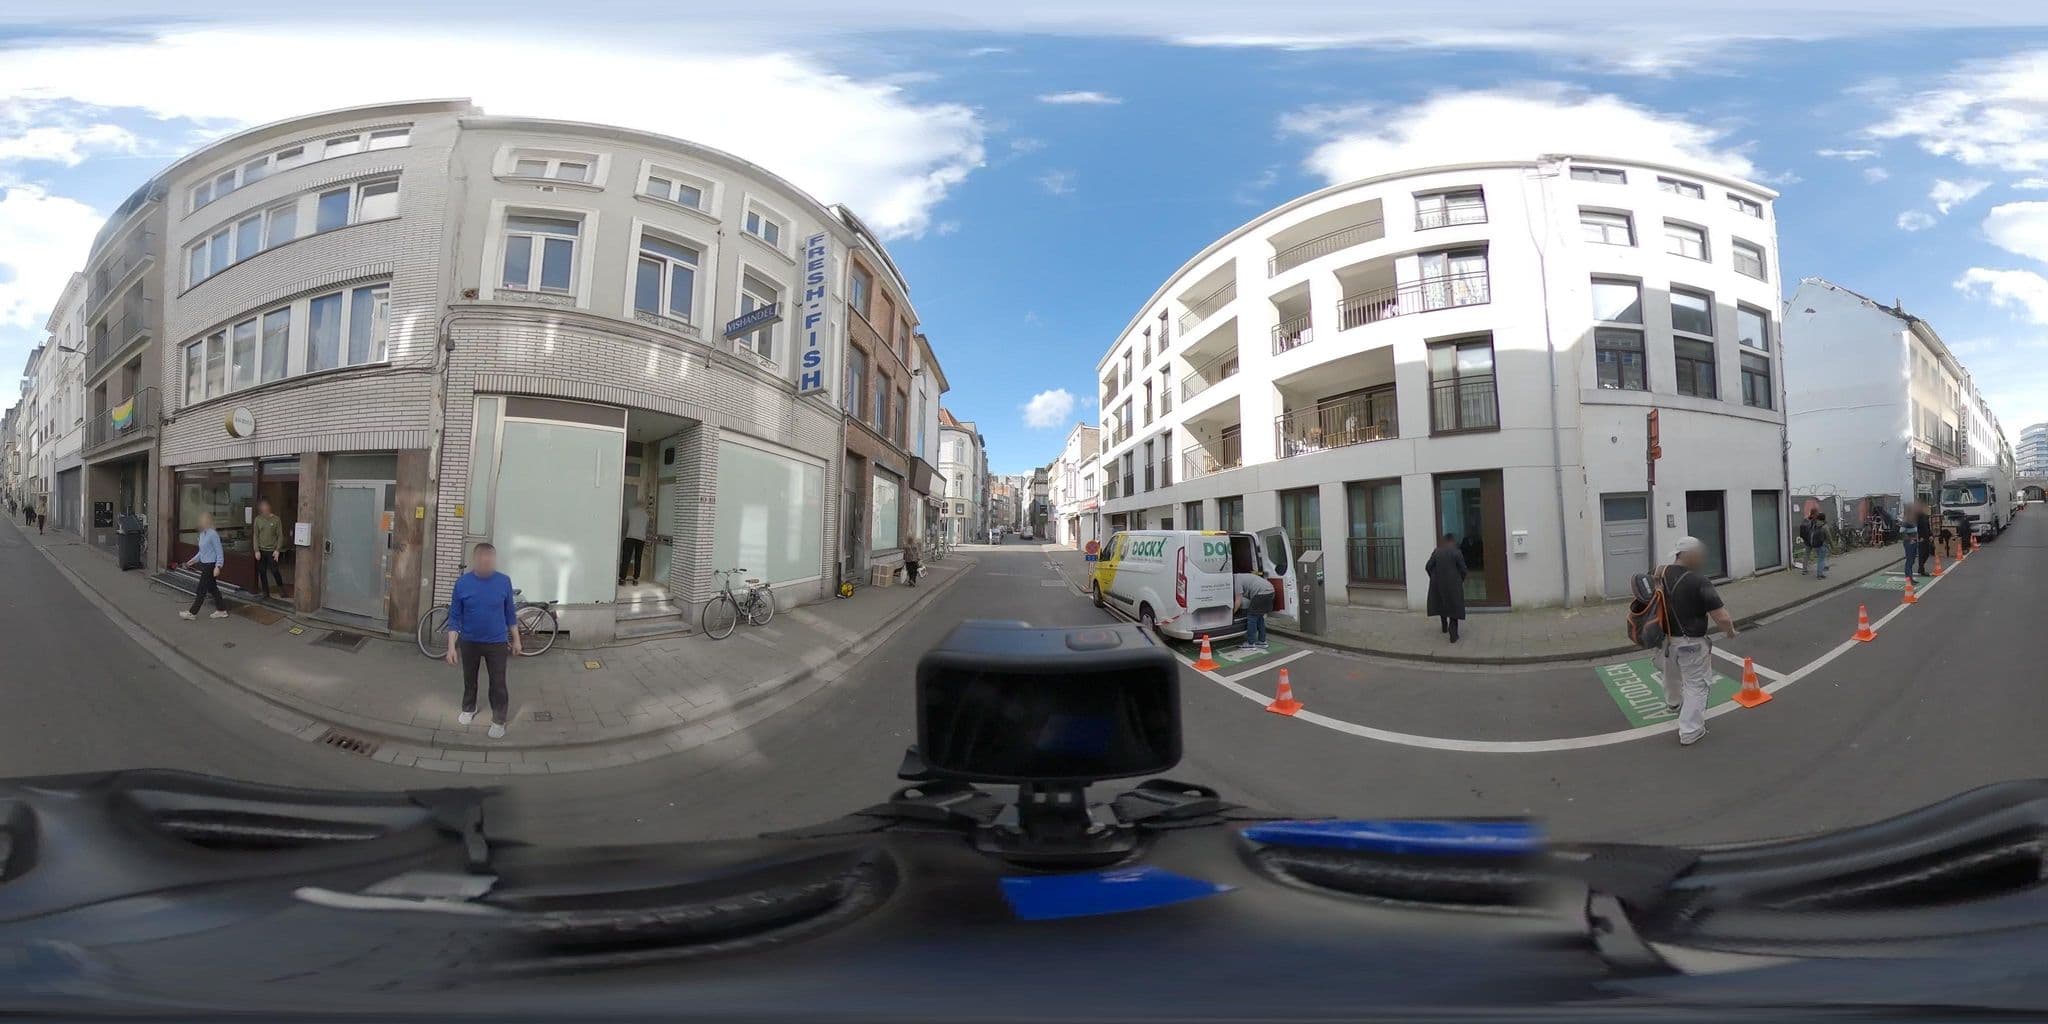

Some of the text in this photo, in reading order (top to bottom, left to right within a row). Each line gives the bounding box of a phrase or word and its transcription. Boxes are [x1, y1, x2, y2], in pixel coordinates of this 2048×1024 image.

[727, 307, 776, 332] VISHANDEL
[802, 234, 825, 390] FRESH-FISH
[1132, 538, 1167, 557] DOCKX
[1603, 663, 1678, 720] AUTODELEN
